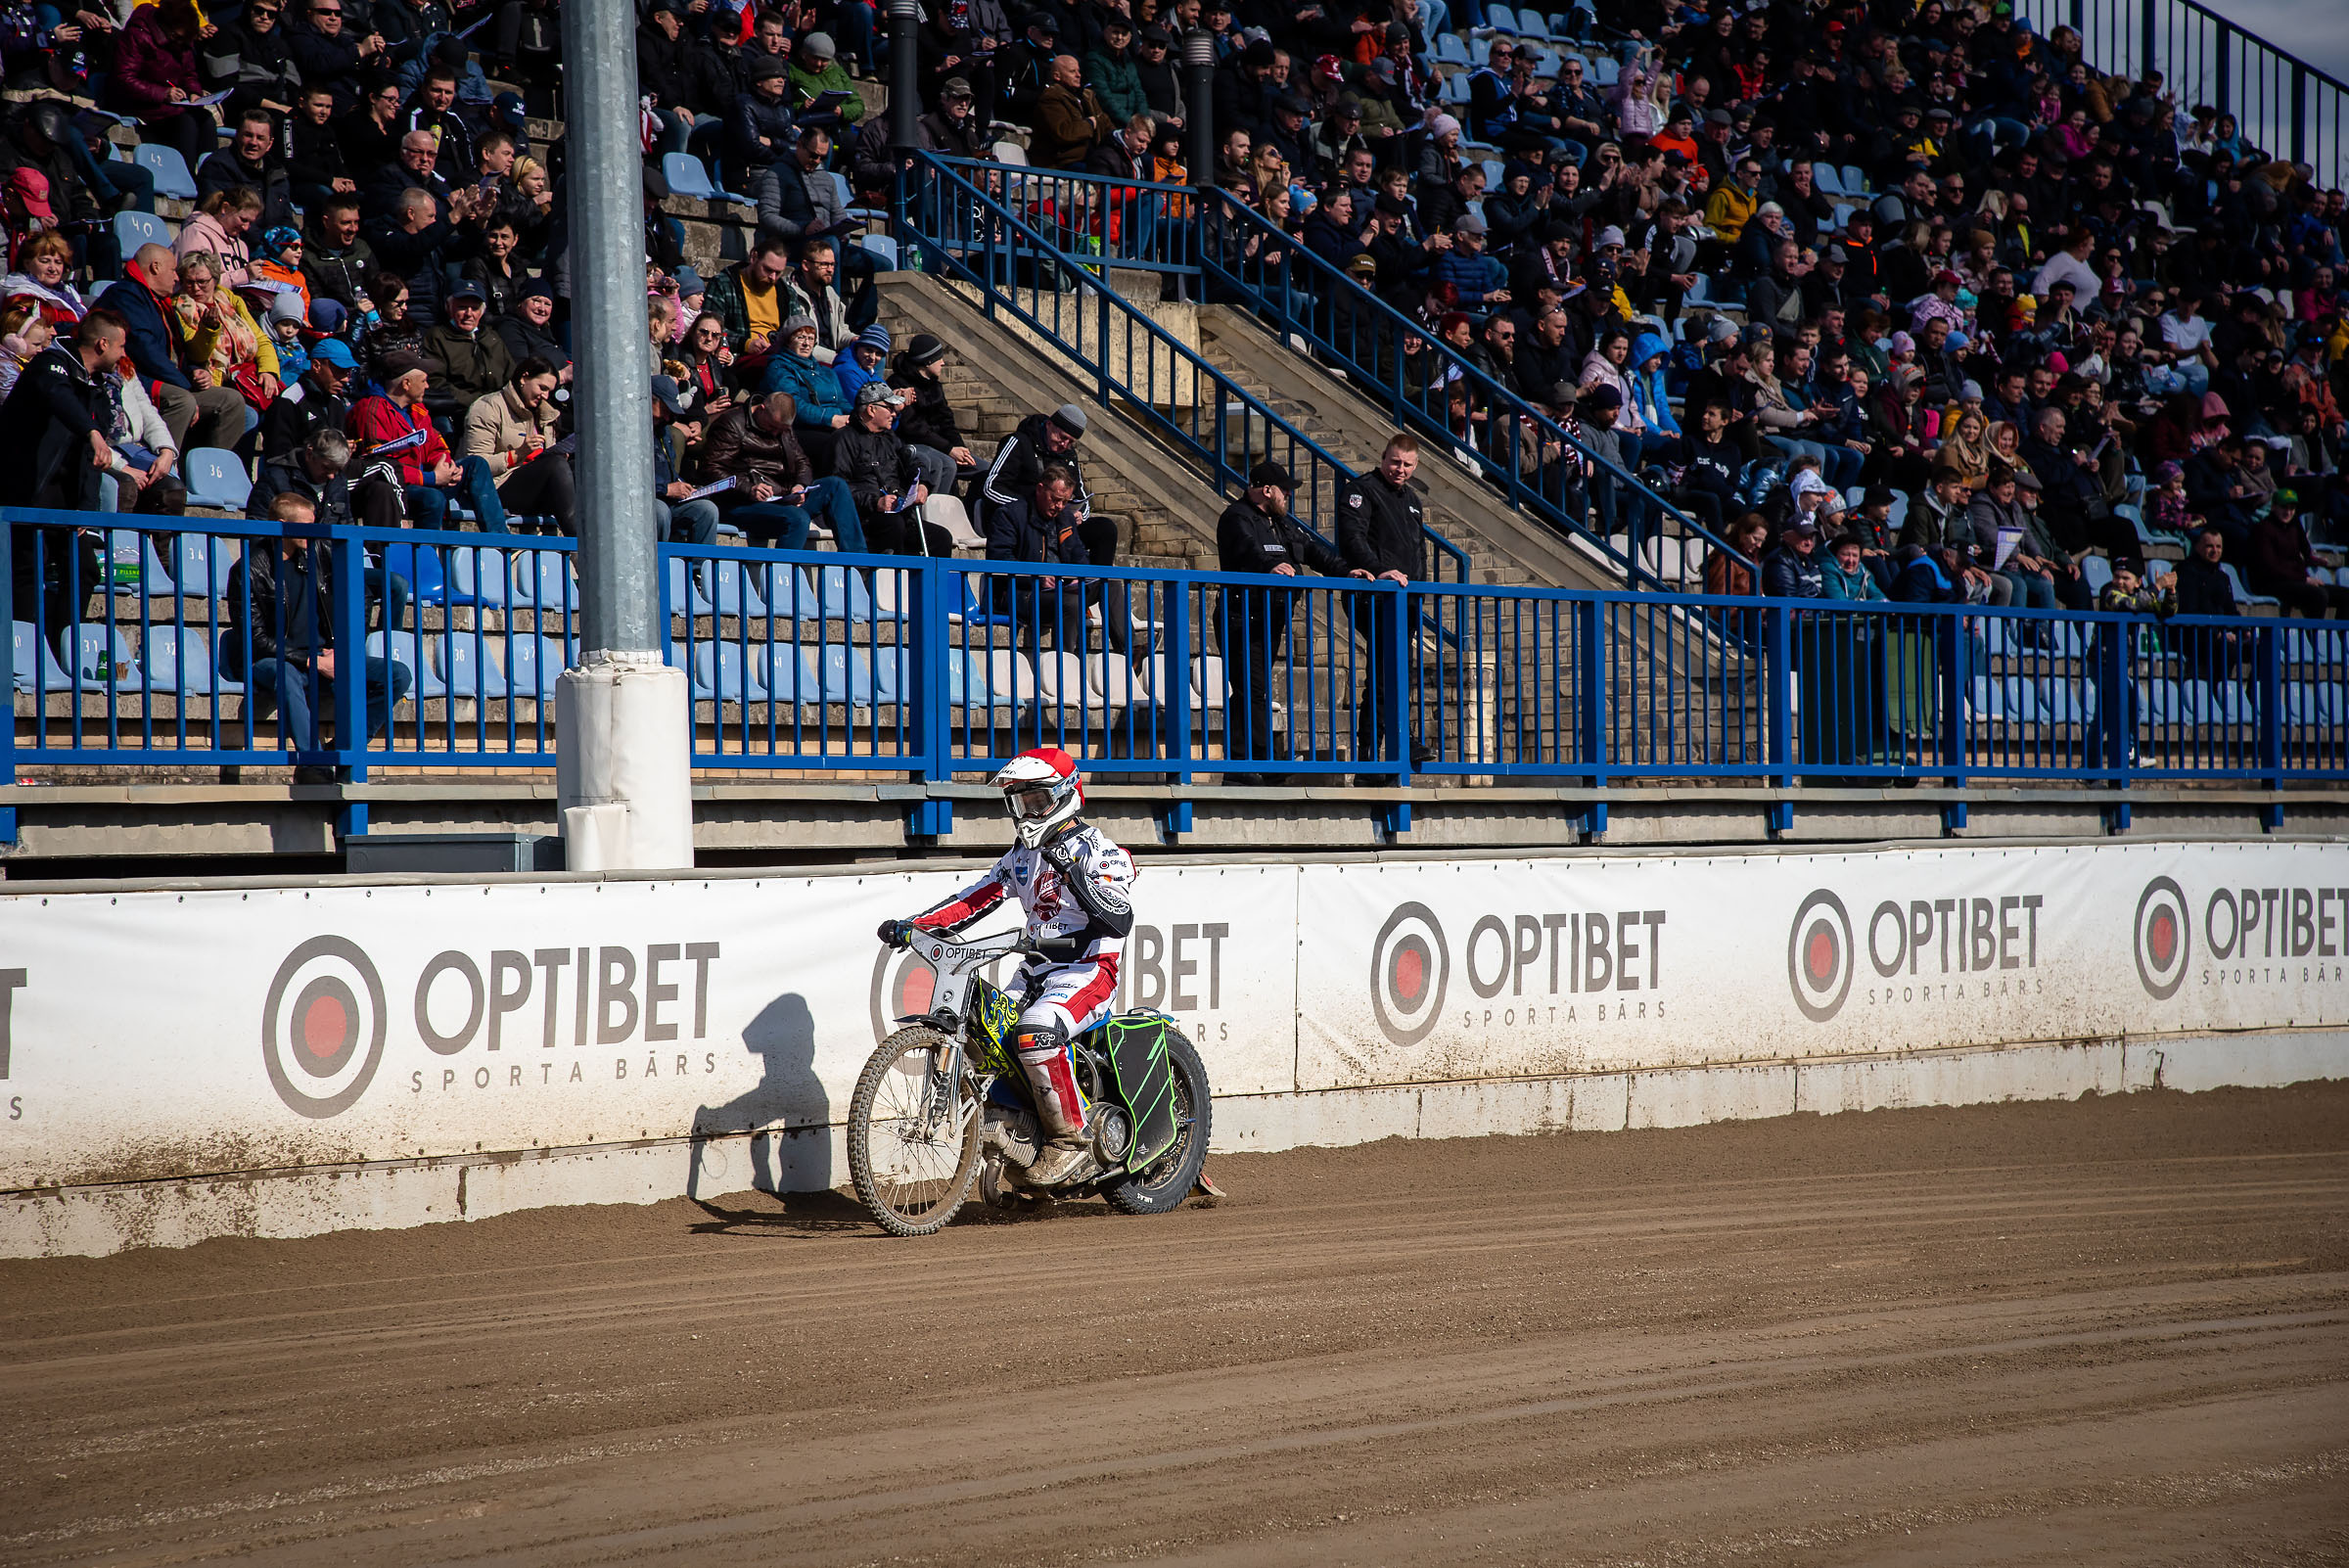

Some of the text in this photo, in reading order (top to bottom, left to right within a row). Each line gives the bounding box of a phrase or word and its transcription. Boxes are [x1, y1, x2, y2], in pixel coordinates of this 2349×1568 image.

[131, 215, 153, 238] 40
[209, 464, 223, 479] 36
[778, 575, 790, 586] 43
[83, 639, 98, 653] 31
[1868, 895, 2044, 978] OPTIBET
[945, 946, 987, 959] OPTIBET
[1466, 910, 1666, 998] OPTIBET
[1116, 923, 1229, 1014] IBET
[2202, 962, 2342, 986] SPORTA BĀR
[414, 942, 720, 1056] OPTIBET
[1868, 977, 2044, 1006] SPORTA BĀRS
[1463, 998, 1665, 1029] SPORTA BĀRS
[411, 1050, 715, 1093] SPORTA BĀRS
